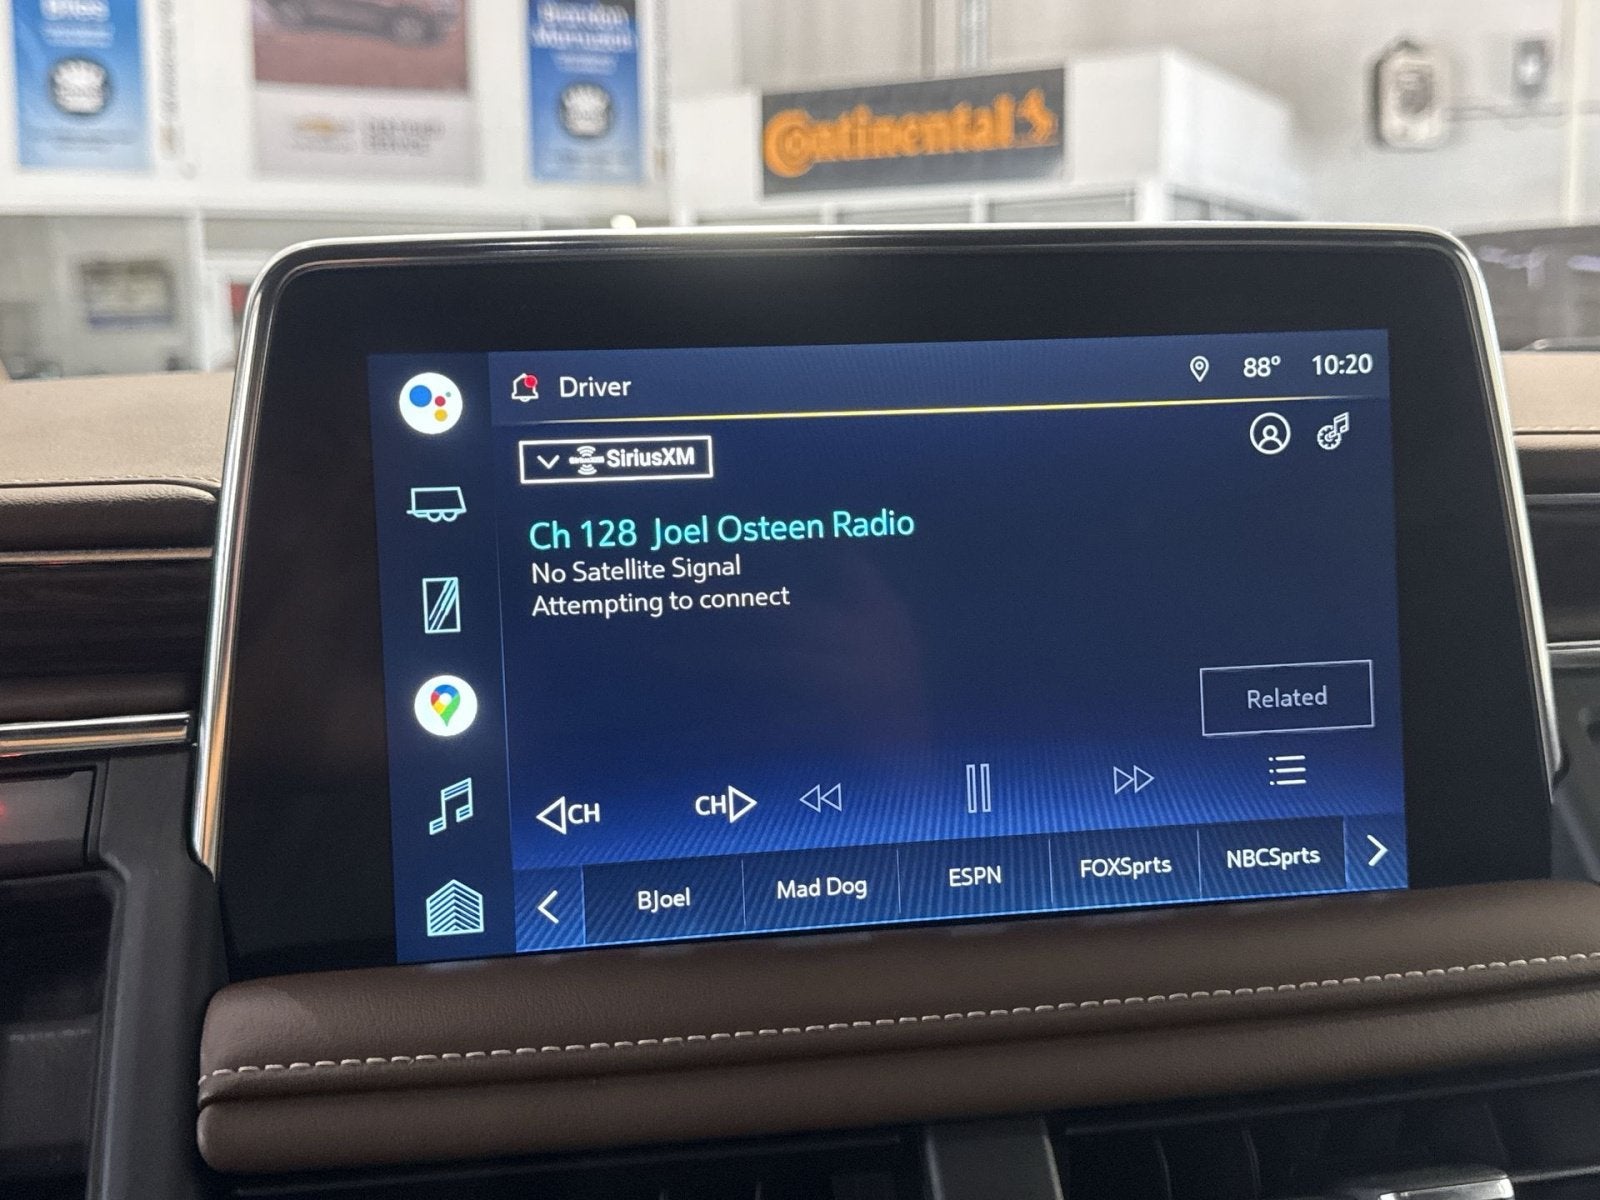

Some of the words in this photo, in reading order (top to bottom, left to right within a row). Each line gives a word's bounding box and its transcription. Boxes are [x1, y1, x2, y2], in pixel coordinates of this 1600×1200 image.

[764, 93, 1015, 178] Continental
[1311, 353, 1373, 376] 10:20
[559, 376, 632, 398] Driver
[606, 446, 695, 468] SiriusXM
[529, 520, 571, 551] Ch
[580, 518, 638, 548] 128
[650, 514, 709, 551] Joel
[717, 514, 824, 543] Osteen
[832, 507, 915, 538] Radio
[531, 562, 567, 584] No
[572, 557, 666, 583] Satellite
[671, 553, 741, 584] Signal
[531, 592, 664, 620] Attempting
[668, 593, 694, 611] to
[699, 586, 791, 609] connect
[1247, 684, 1328, 709] Related
[567, 802, 601, 825] CH
[695, 794, 727, 816] CH
[1080, 856, 1173, 880] FOXSprts
[1226, 847, 1321, 871] NBCSprts
[777, 877, 821, 900] Mad
[826, 876, 868, 900] Dog
[949, 865, 1002, 887] ESPN
[637, 886, 691, 914] BJoel
